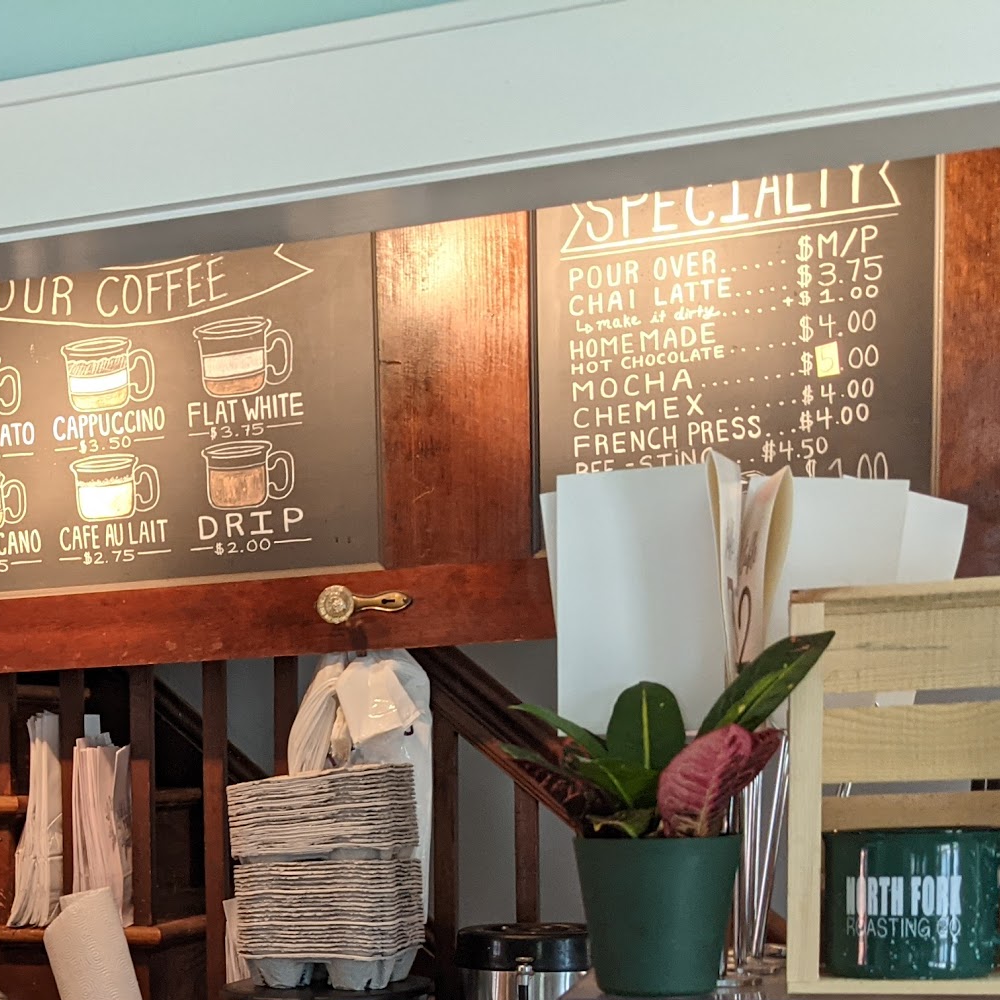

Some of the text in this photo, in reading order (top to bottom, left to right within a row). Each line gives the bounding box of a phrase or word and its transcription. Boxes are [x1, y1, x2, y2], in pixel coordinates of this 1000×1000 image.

[568, 225, 878, 291] POUR OVER $M/P
[96, 256, 229, 318] COFFEE
[568, 255, 884, 316] CHAI LATTE $3.75
[596, 314, 642, 331] make
[649, 309, 667, 324] it
[673, 304, 720, 320] dirty
[798, 309, 877, 343] $4.00
[570, 344, 725, 375] HOT CHOCOLATE
[572, 368, 693, 402] MOCHA
[188, 392, 304, 428] FLAT WHITE
[573, 377, 875, 429] CHEMEX $4.00
[52, 406, 166, 442] CAPPUCCINO
[210, 424, 265, 440] $3.75
[573, 403, 869, 458] FRENCH PRESS $4.00
[78, 436, 132, 454] $3.50
[761, 436, 829, 463] $4.50
[59, 518, 169, 551] CAFE AU LAIT
[198, 507, 304, 541] DRIP
[83, 550, 136, 566] $2.75
[214, 538, 272, 556] $2.00
[846, 875, 963, 917] NORTH FORK
[846, 917, 931, 938] ROASTING
